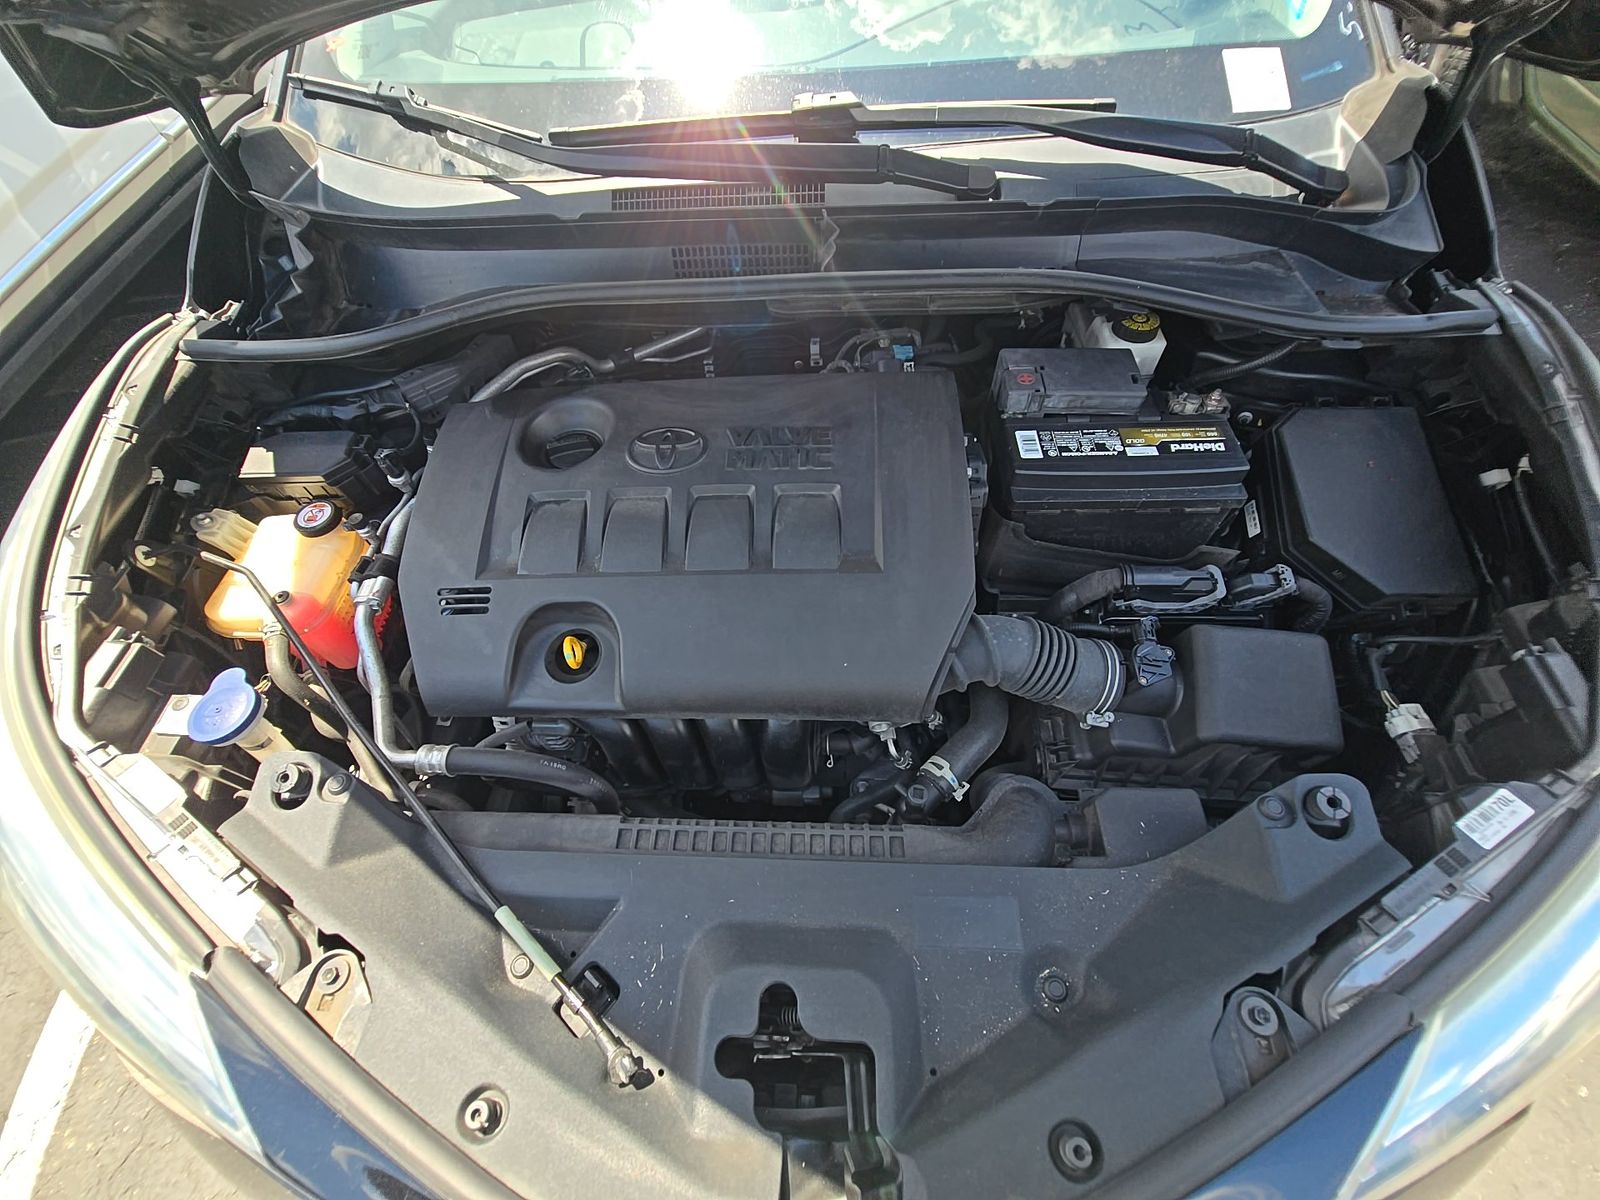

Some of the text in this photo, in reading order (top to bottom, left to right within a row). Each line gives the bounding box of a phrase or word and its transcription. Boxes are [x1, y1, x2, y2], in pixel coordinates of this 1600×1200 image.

[725, 425, 833, 448] VALVE
[1170, 442, 1226, 453] DieHard
[724, 448, 833, 471] MATIC
